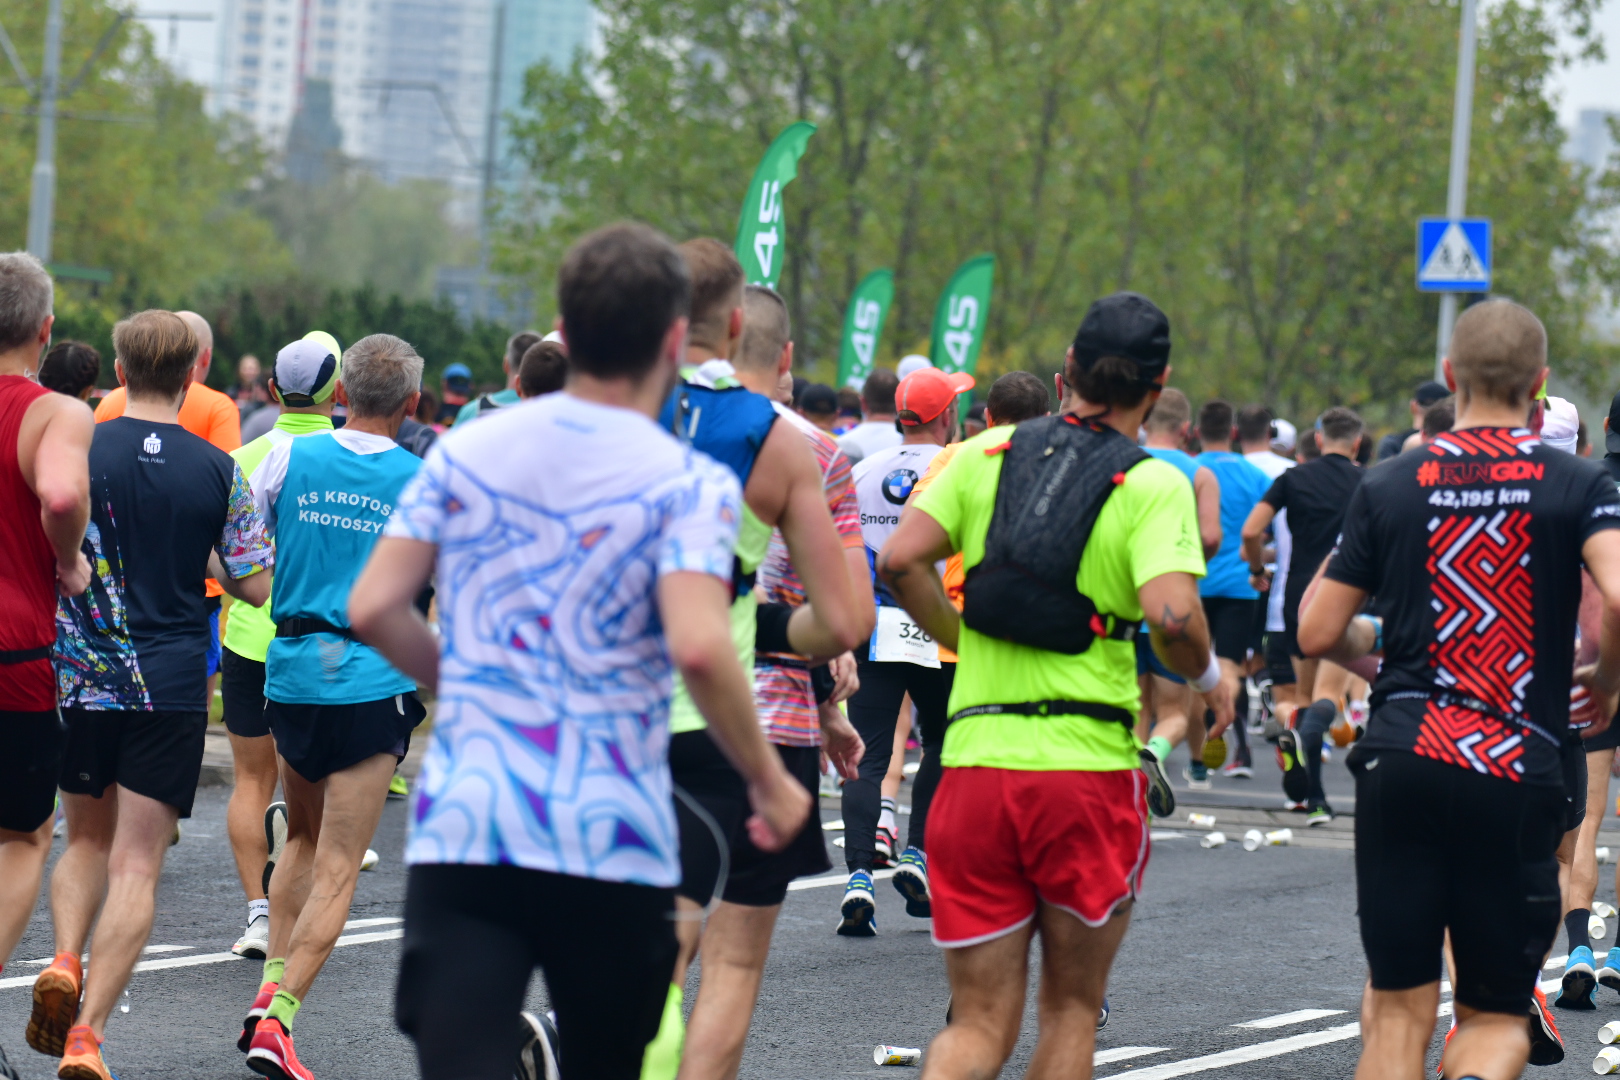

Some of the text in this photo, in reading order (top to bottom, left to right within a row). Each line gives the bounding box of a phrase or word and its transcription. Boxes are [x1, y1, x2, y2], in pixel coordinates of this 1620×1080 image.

[297, 490, 394, 517] KS KROTOS
[1428, 487, 1531, 509] 42,195 km
[298, 509, 385, 534] KROTOSZY
[860, 513, 899, 525] Smora
